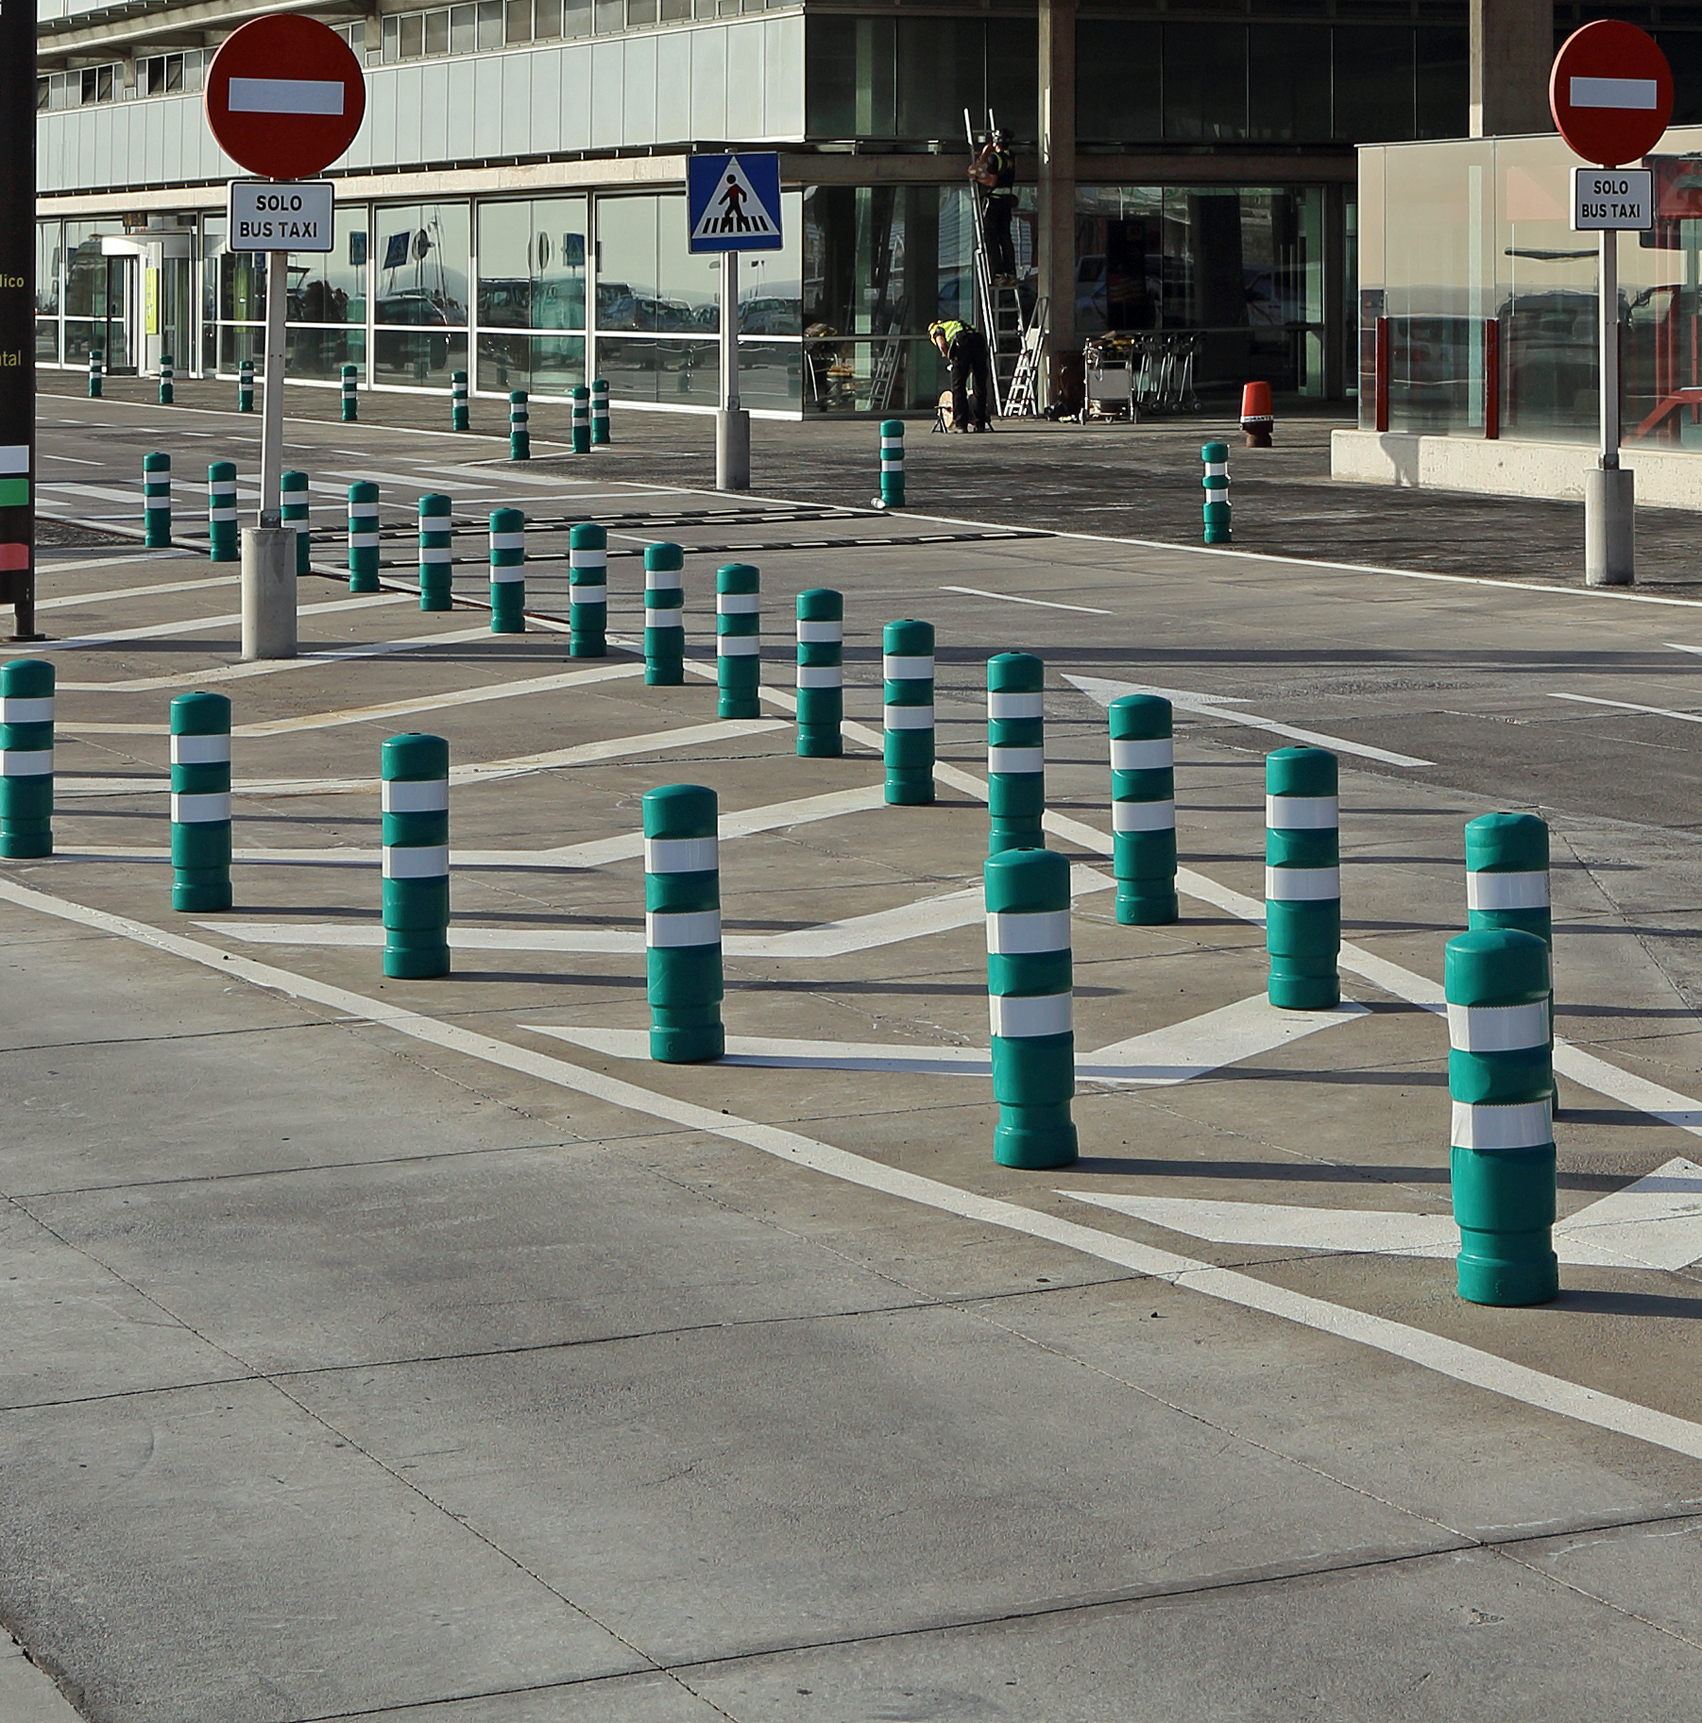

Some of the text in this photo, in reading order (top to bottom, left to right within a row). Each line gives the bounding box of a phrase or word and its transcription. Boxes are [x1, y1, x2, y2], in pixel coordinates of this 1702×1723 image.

[1593, 179, 1629, 195] SOLO
[255, 194, 303, 212] SOLO
[1581, 203, 1640, 218] BUS TAXI
[239, 221, 318, 238] BUS TAXI
